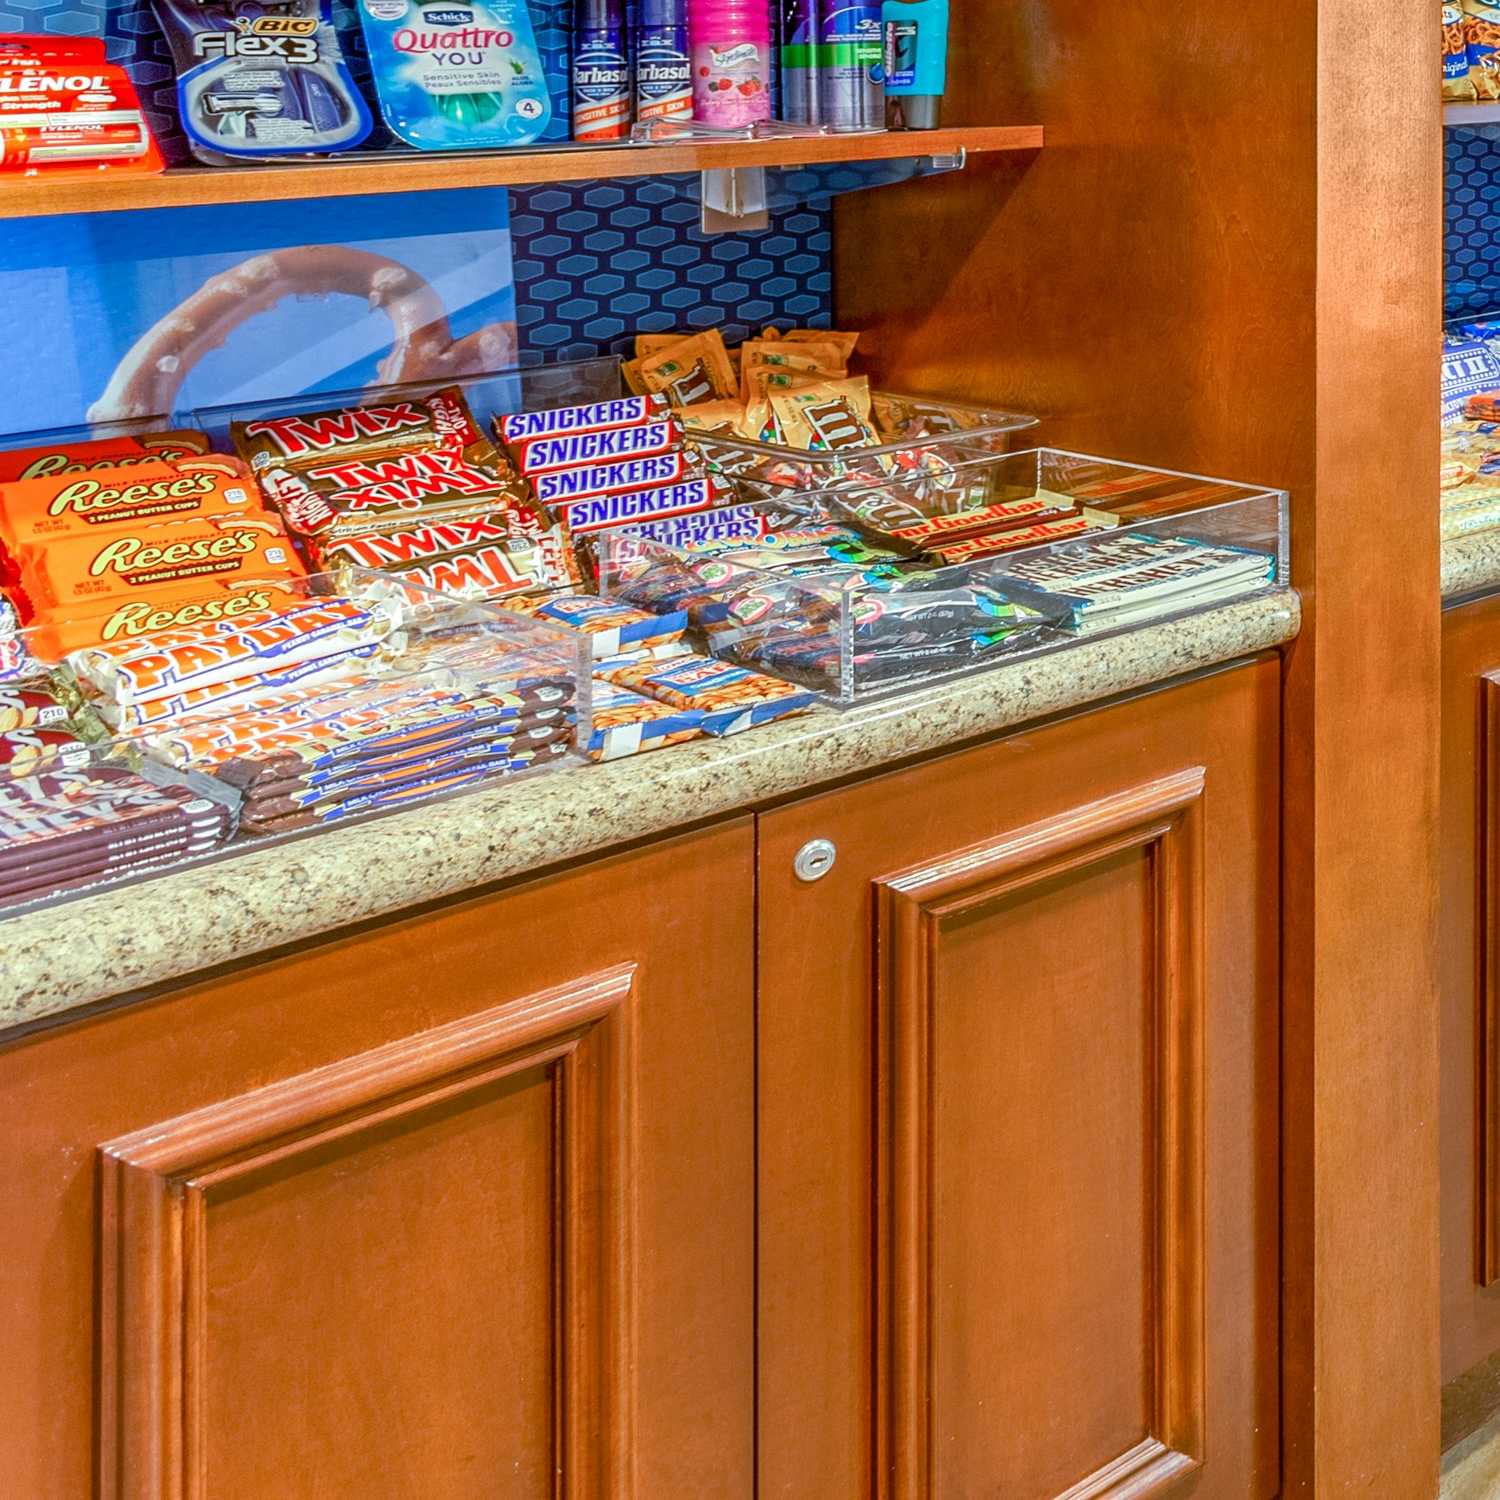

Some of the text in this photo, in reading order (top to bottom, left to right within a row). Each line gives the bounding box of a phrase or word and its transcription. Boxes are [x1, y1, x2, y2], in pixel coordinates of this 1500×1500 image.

[427, 11, 472, 25] Schick
[393, 27, 514, 54] Quattro
[432, 52, 484, 66] YOU
[423, 71, 501, 81] Sensitive Skin
[456, 79, 502, 88] Sensibles
[2, 101, 62, 110] Strength
[523, 101, 535, 113] 4
[508, 396, 643, 439] SNICKERS
[528, 423, 666, 468] SNICKERS
[540, 454, 676, 500] SNICKERS
[48, 472, 217, 517] Reese's
[571, 479, 705, 526] SNICKERS
[98, 500, 199, 522] PEANUT BUTTER CUPS
[90, 530, 258, 577] Reese's
[138, 560, 240, 583] PEANUT BUTTER CUPS
[281, 616, 364, 650] PEANUT CARAMEL BAR
[288, 646, 371, 678] PEANUT CARAMEL BAR
[43, 707, 64, 719] 210
[408, 718, 445, 731] ENGLISH
[478, 706, 497, 717] BAR
